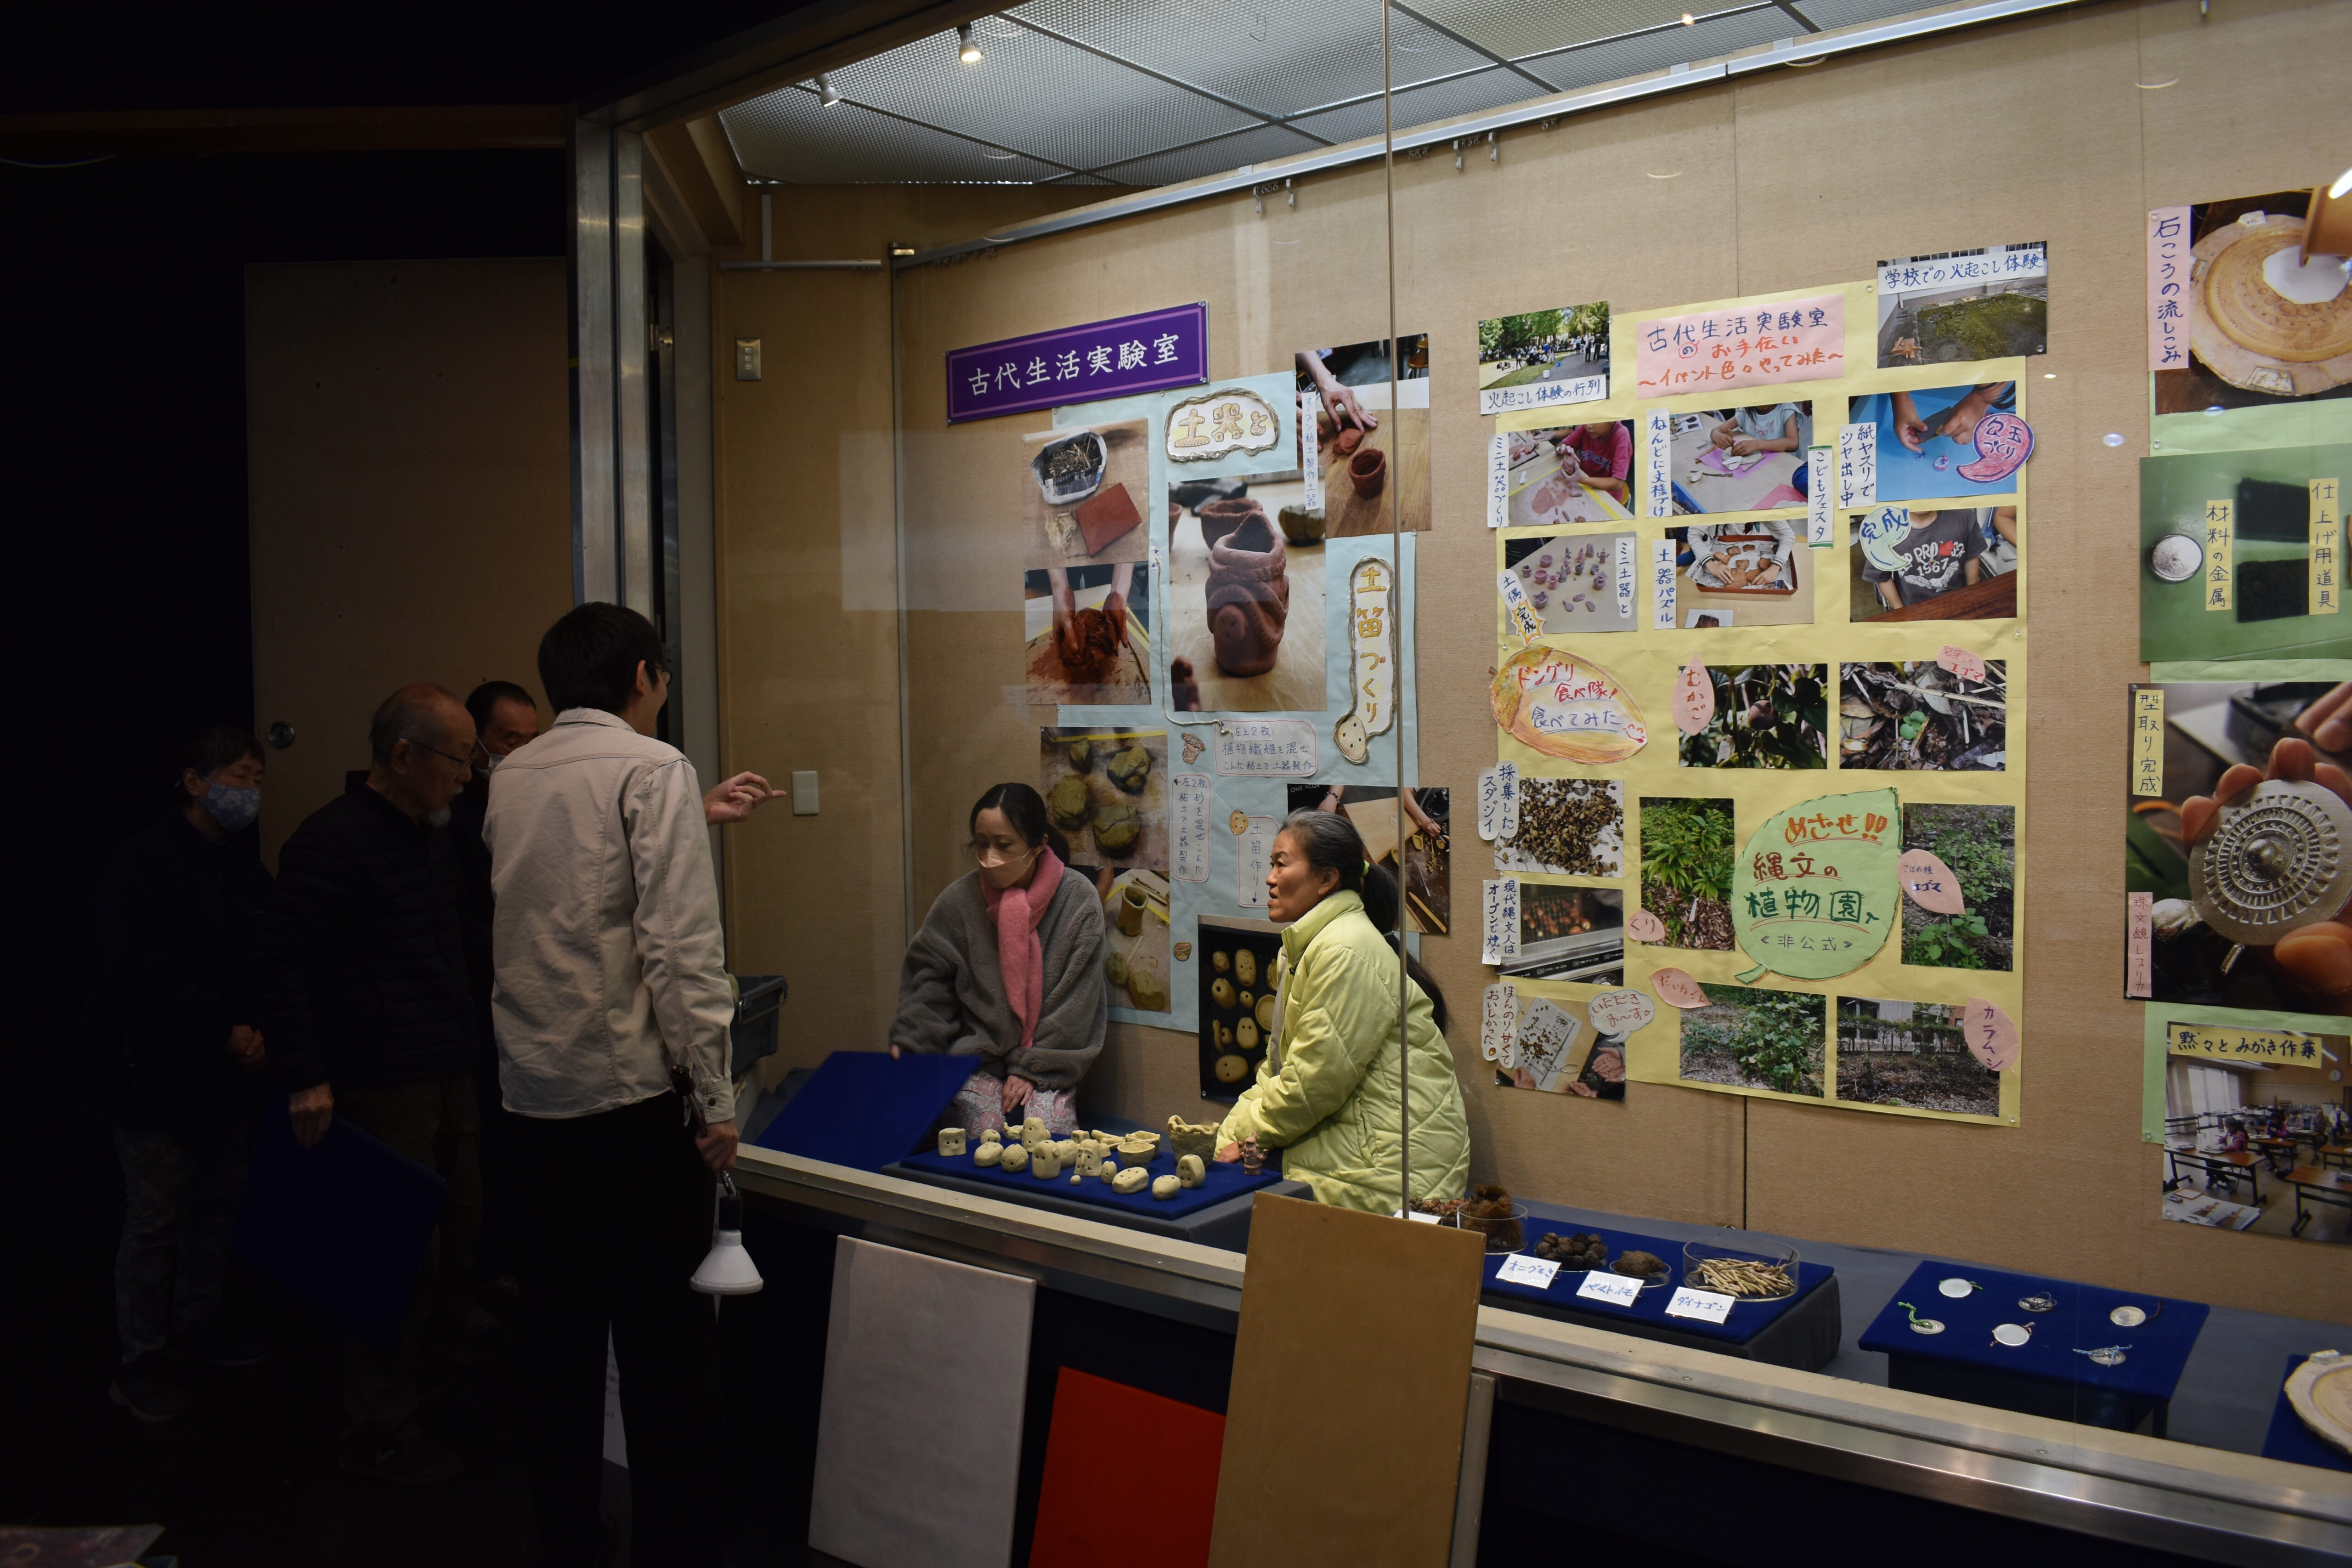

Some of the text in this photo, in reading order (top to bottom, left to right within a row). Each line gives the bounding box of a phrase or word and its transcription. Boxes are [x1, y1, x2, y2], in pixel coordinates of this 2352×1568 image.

[1885, 253, 2043, 289] 学校での火起こし体験
[2153, 216, 2183, 363] 石こうの流しこみ
[1647, 307, 1828, 352] 古代生活実験室
[1712, 335, 1799, 359] お手伝い
[968, 333, 1179, 396] 古代生活実験室
[1488, 379, 1601, 409] 火起こし体験の行列
[1983, 441, 2015, 459] づくり
[1986, 417, 2023, 443] 勾玉
[1495, 437, 1506, 526] ミニ土器づくり
[1651, 416, 1668, 517] ねんどに文様づけ
[1840, 432, 1854, 507] ツヤ出し中
[1857, 425, 1876, 497] 紙ヤスリで
[1815, 451, 1828, 541] こどもフェスタ
[2206, 505, 2230, 607] 材料の金属
[2312, 483, 2337, 608] 仕上げ用道具
[1503, 576, 1522, 603] 土偶
[1618, 542, 1632, 614] ミニ土器と
[1655, 549, 1675, 623] 土器パズル
[1356, 566, 1387, 723] 土笛づくり
[1516, 607, 1536, 634] 完成
[1518, 662, 1573, 691] ドングリ
[1687, 669, 1706, 720] むかご
[1948, 662, 1984, 680] エゴマ
[1531, 706, 1622, 728] 食べてみた
[2138, 694, 2161, 792] 型取り完成
[1224, 761, 1314, 770] こんだ粘土で土器製作
[1483, 776, 1498, 833] スダジイ
[1498, 764, 1515, 830] 採集した
[1250, 823, 1263, 886] 土笛作り
[1753, 852, 1838, 881] 縄文の
[1486, 884, 1499, 959] オーブンで焼く
[1502, 880, 1516, 954] 現代縄文人は
[1630, 918, 1655, 933] くり
[2133, 896, 2148, 991] 珠文鏡レプリカ
[1592, 994, 1640, 1013] いただき
[1660, 975, 1705, 1003] だいなごん
[1484, 990, 1499, 1045] おいしかった
[1501, 986, 1515, 1065] ほんのり甘くて
[1982, 1006, 2003, 1069] カラムシ
[2178, 1031, 2316, 1059] 黙々とみがき作業
[1508, 1260, 1555, 1279] オニグルミ
[1676, 1296, 1726, 1312] ダイナゴン
